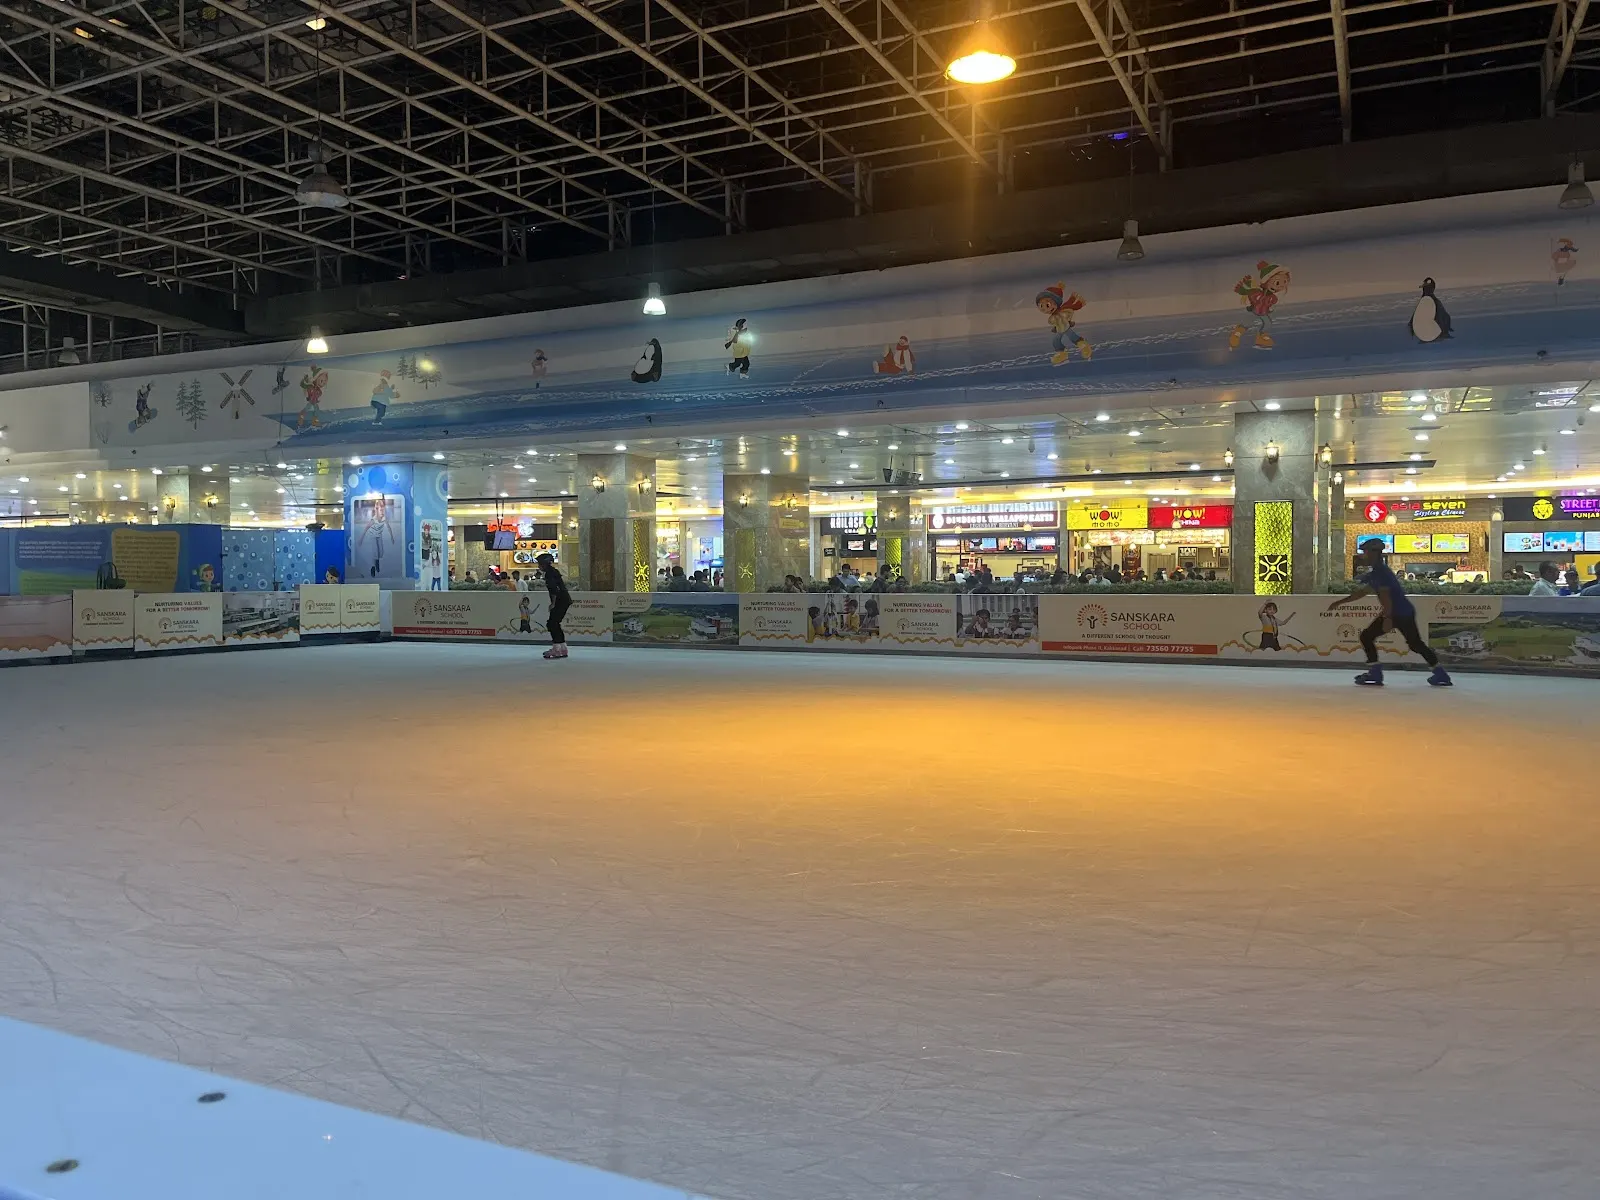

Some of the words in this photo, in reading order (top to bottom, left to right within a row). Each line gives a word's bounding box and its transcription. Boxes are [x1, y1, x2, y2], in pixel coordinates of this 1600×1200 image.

[1423, 501, 1466, 510] seven
[1560, 500, 1596, 508] STREET
[1110, 612, 1175, 622] SANSKARA
